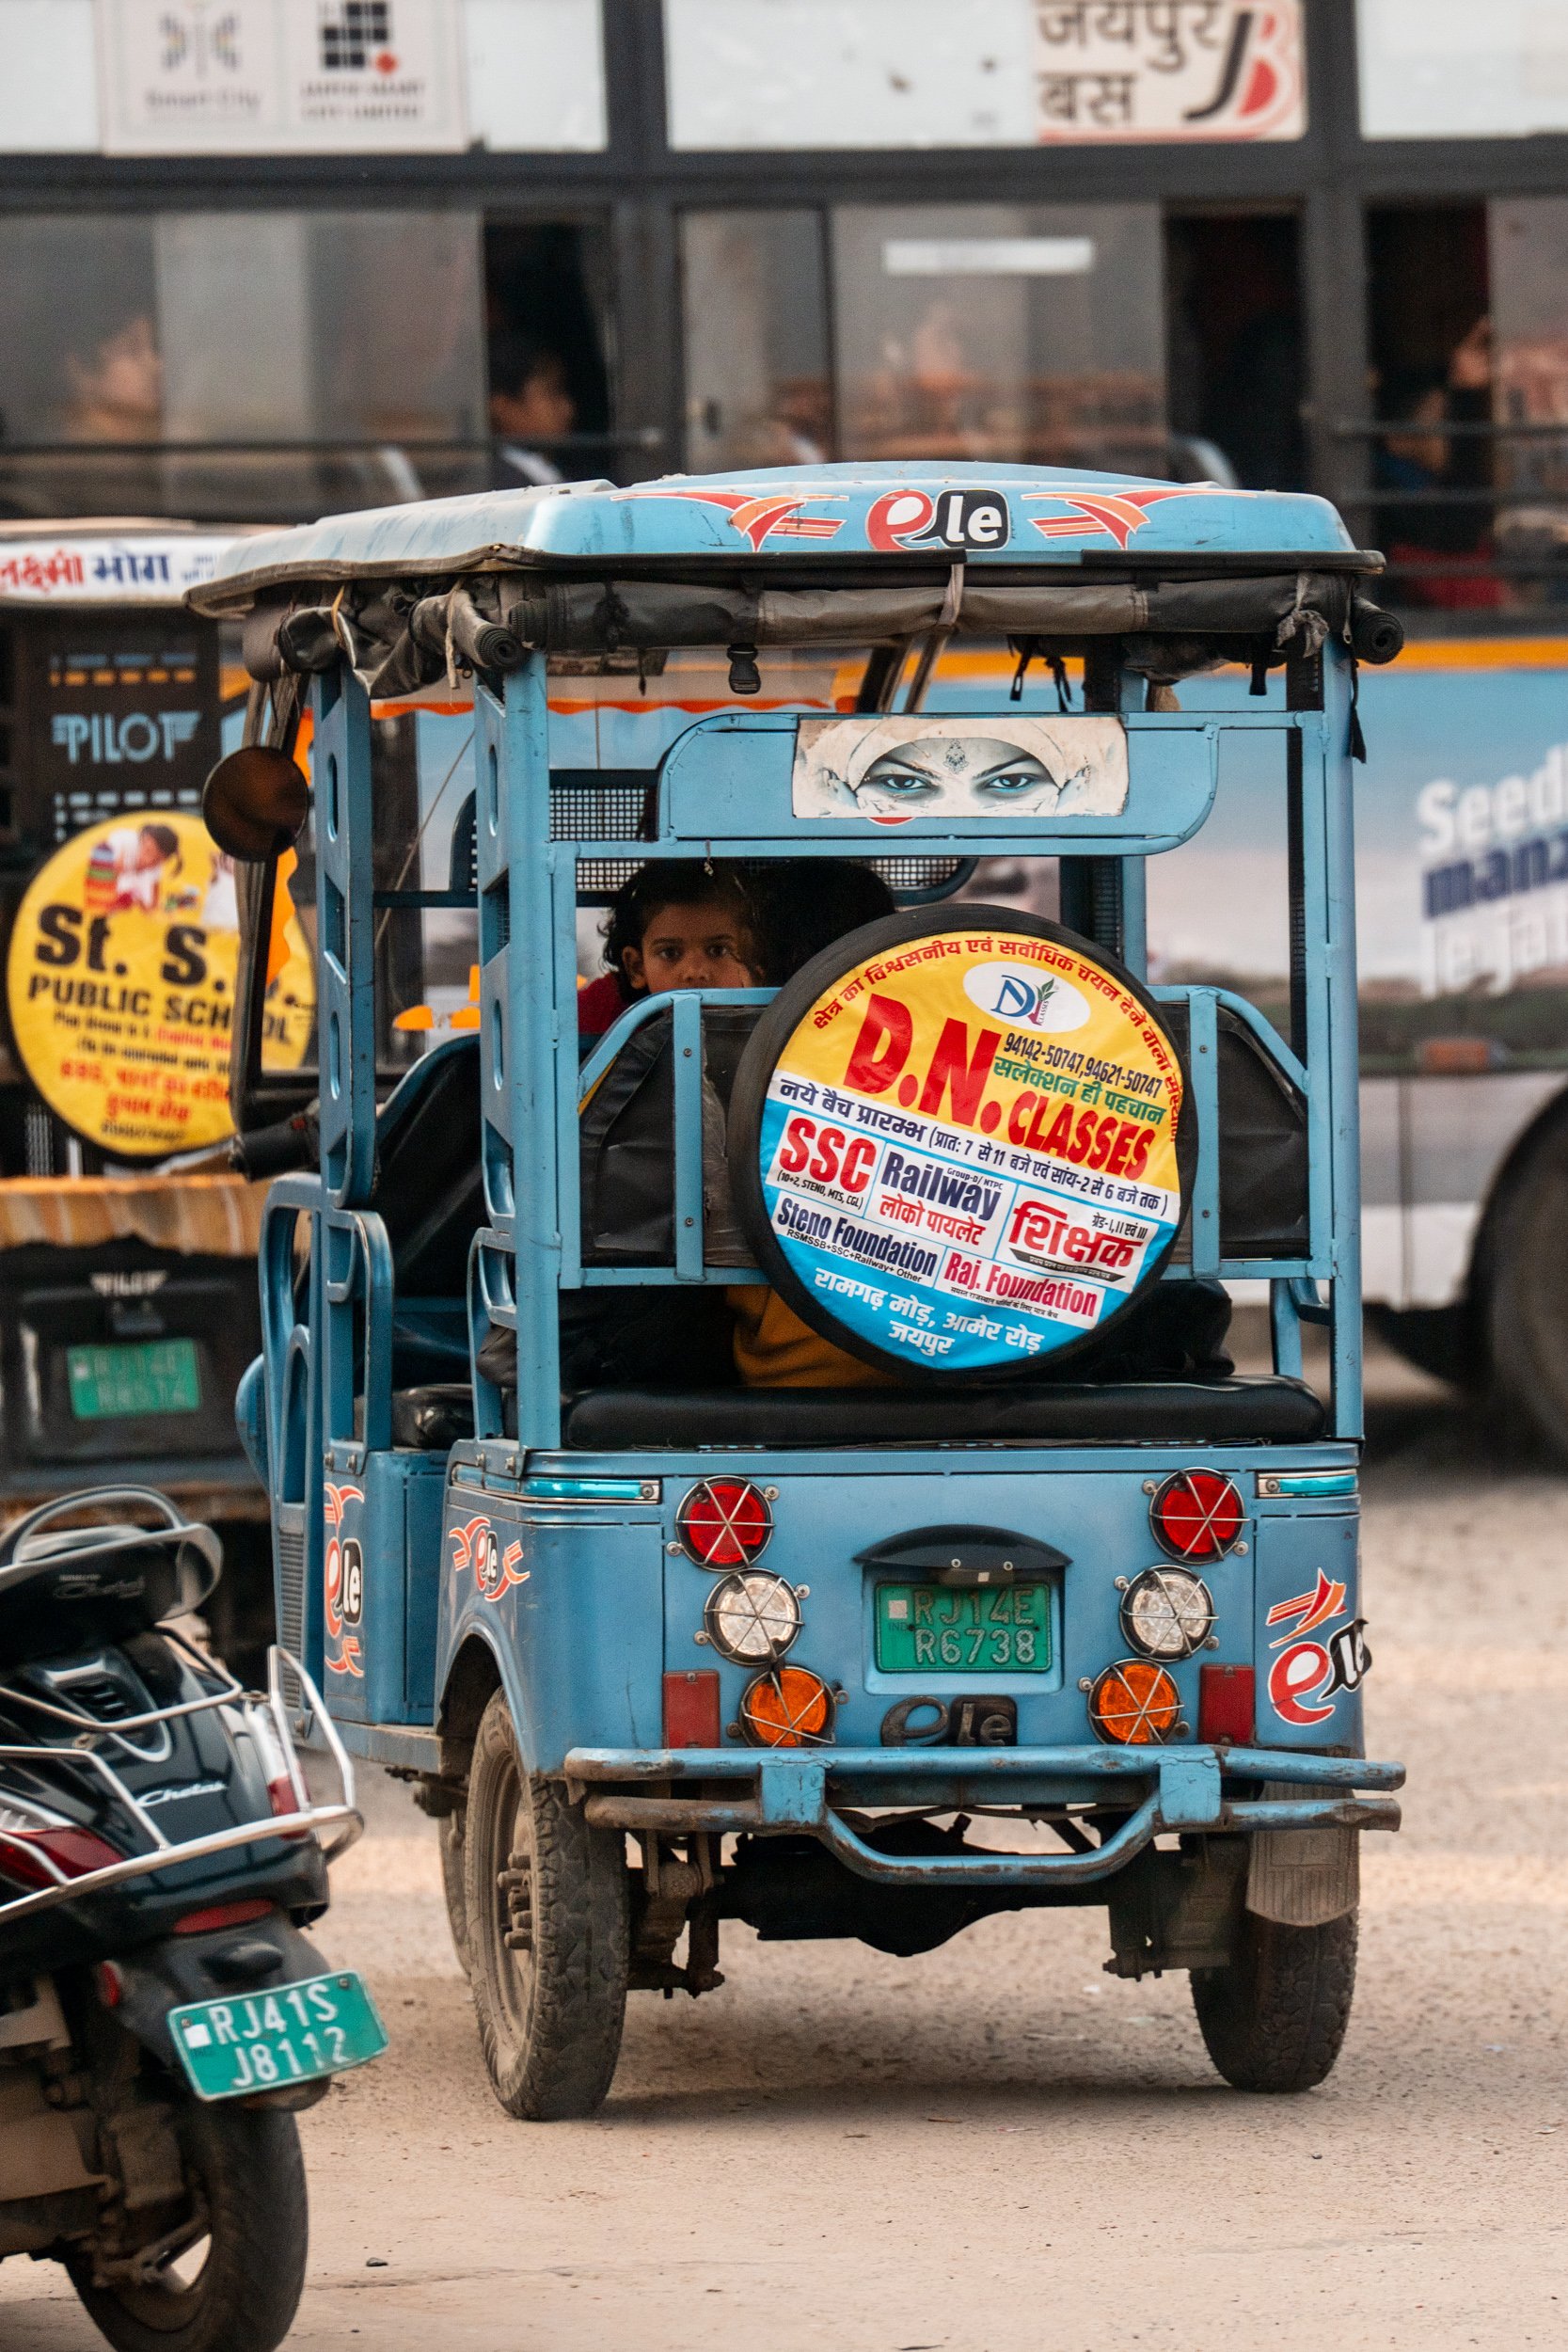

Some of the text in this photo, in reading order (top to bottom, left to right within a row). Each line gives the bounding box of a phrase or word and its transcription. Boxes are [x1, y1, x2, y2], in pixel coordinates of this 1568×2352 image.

[1037, 0, 1225, 73] जयपुर
[1037, 72, 1135, 123] बस
[866, 489, 1009, 550] ele
[51, 710, 201, 765] PILOT
[1417, 743, 1568, 858] Seed
[35, 903, 226, 993] St. S.
[28, 974, 150, 1017] PUBLIC
[812, 998, 844, 1029] क्षेत्र
[840, 977, 864, 1002] का
[863, 940, 961, 986] विश्वसनीय
[966, 937, 993, 954] एवं
[1077, 963, 1121, 1002] चयन
[1119, 995, 1147, 1028] देने
[1141, 1025, 1172, 1072] वाला
[843, 993, 1156, 1181] D.N. CLASSES
[992, 1056, 1166, 1125] सलेक्शन ही पहचान
[779, 1118, 877, 1193] SSC
[780, 1079, 818, 1106] नये
[821, 1089, 855, 1121] बैच
[858, 1104, 927, 1142] प्रारम्भ
[964, 1140, 974, 1155] 7
[978, 1141, 991, 1161] से
[993, 1149, 1006, 1166] 11
[1010, 1153, 1031, 1175] बजे
[1032, 1159, 1051, 1180] एवं
[1090, 1178, 1104, 1196] से
[1104, 1184, 1113, 1200] 6
[1116, 1186, 1138, 1207] बजे
[1138, 1193, 1161, 1211] तक
[801, 1179, 826, 1197] STENO,
[828, 1188, 846, 1203] MTS,
[880, 1152, 1002, 1221] Railway
[984, 1178, 1005, 1190] NTPC
[777, 1198, 939, 1278] Steno Foundation
[879, 1194, 986, 1246] लोको पायलेट
[1008, 1200, 1144, 1268] शिक्षक
[896, 1268, 923, 1283] Other
[943, 1251, 981, 1290] Raj.
[985, 1264, 1098, 1317] Foundation
[814, 1267, 889, 1311] रामगढ़
[942, 1311, 1004, 1342] आमेर
[1004, 1324, 1045, 1356] रोड़
[888, 1321, 956, 1357] जयपुर
[913, 1590, 1034, 1626] RJ14E
[914, 1629, 1035, 1664] R6738
[208, 1983, 338, 2044] RJ41S
[233, 2026, 349, 2087] J8112
